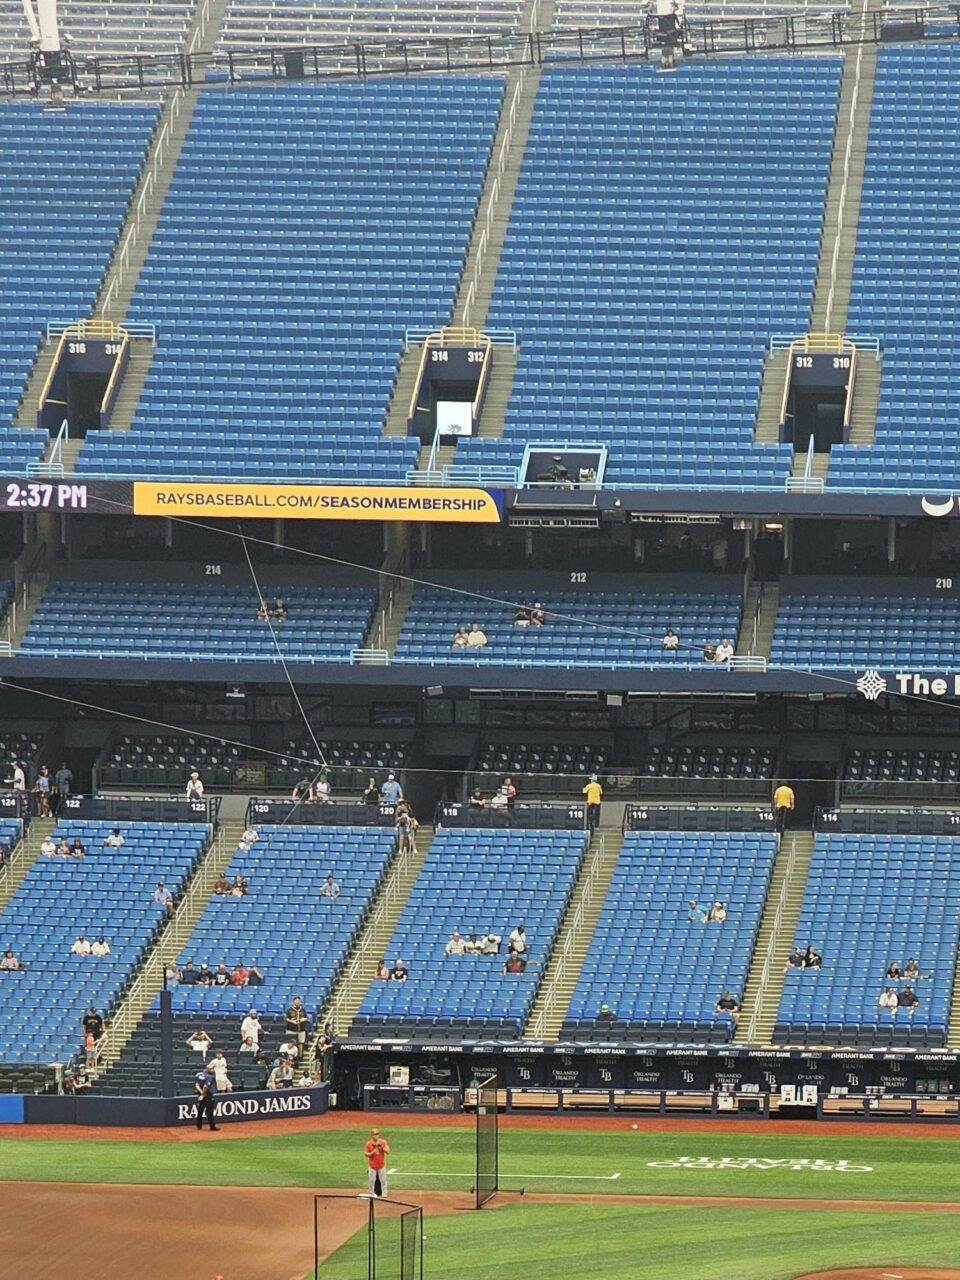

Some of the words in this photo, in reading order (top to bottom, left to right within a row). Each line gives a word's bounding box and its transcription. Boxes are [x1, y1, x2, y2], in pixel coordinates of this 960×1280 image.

[68, 343, 86, 354] 316
[431, 350, 449, 362] 314
[467, 351, 484, 363] 312
[796, 357, 813, 368] 312
[833, 358, 850, 369] 310
[7, 483, 53, 507] 2:37
[58, 485, 87, 508] PM
[156, 492, 486, 511] RAYSBASEBALL.COM/SEASONMEMBERSHIP
[205, 564, 221, 575] 214
[570, 572, 586, 583] 212
[936, 578, 952, 589] 210
[895, 674, 948, 695] The
[1, 798, 16, 807] 124
[65, 800, 81, 808] 122
[191, 803, 206, 811] 122
[254, 804, 270, 813] 120
[379, 806, 394, 815] 120
[443, 808, 458, 817] 118
[569, 811, 583, 819] 118
[632, 811, 648, 819] 116
[759, 813, 774, 821] 116
[823, 813, 838, 822] 114
[517, 1067, 530, 1080] TB
[599, 1068, 612, 1081] TB
[681, 1070, 694, 1082] TB
[763, 1071, 776, 1084] TB
[846, 1073, 859, 1086] TB
[260, 1095, 311, 1113] JAMES
